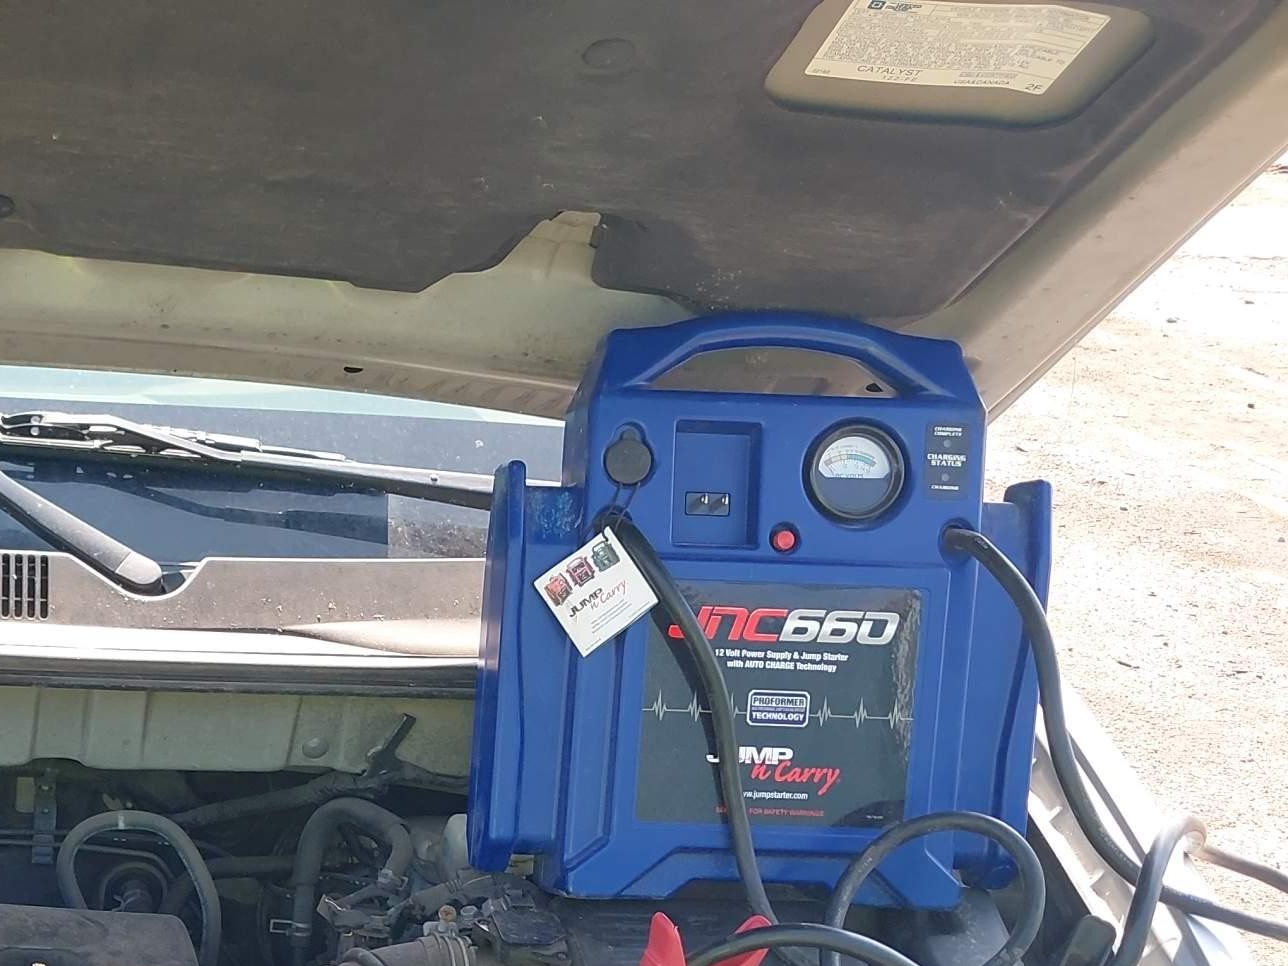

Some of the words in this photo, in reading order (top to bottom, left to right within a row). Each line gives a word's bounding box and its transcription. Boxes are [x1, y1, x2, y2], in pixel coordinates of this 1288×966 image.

[857, 65, 923, 76] CATALYST
[927, 453, 967, 462] CHARGING
[931, 459, 962, 467] STATUS
[599, 580, 627, 604] Carry
[569, 587, 603, 618] JUMP
[715, 649, 725, 657] 12
[726, 649, 741, 658] Volt
[742, 649, 765, 659] Power
[766, 650, 792, 661] Supply
[793, 651, 800, 659] &
[801, 652, 822, 662] Jump
[822, 652, 849, 662] Starter
[727, 659, 744, 668] with
[744, 660, 764, 669] AUTO
[765, 661, 795, 670] CHARGE
[796, 662, 837, 673] Technology
[753, 696, 805, 707] PROFORMER
[752, 711, 805, 722] TECHNOLOGY
[773, 760, 842, 796] Carry
[749, 807, 763, 815] FOR
